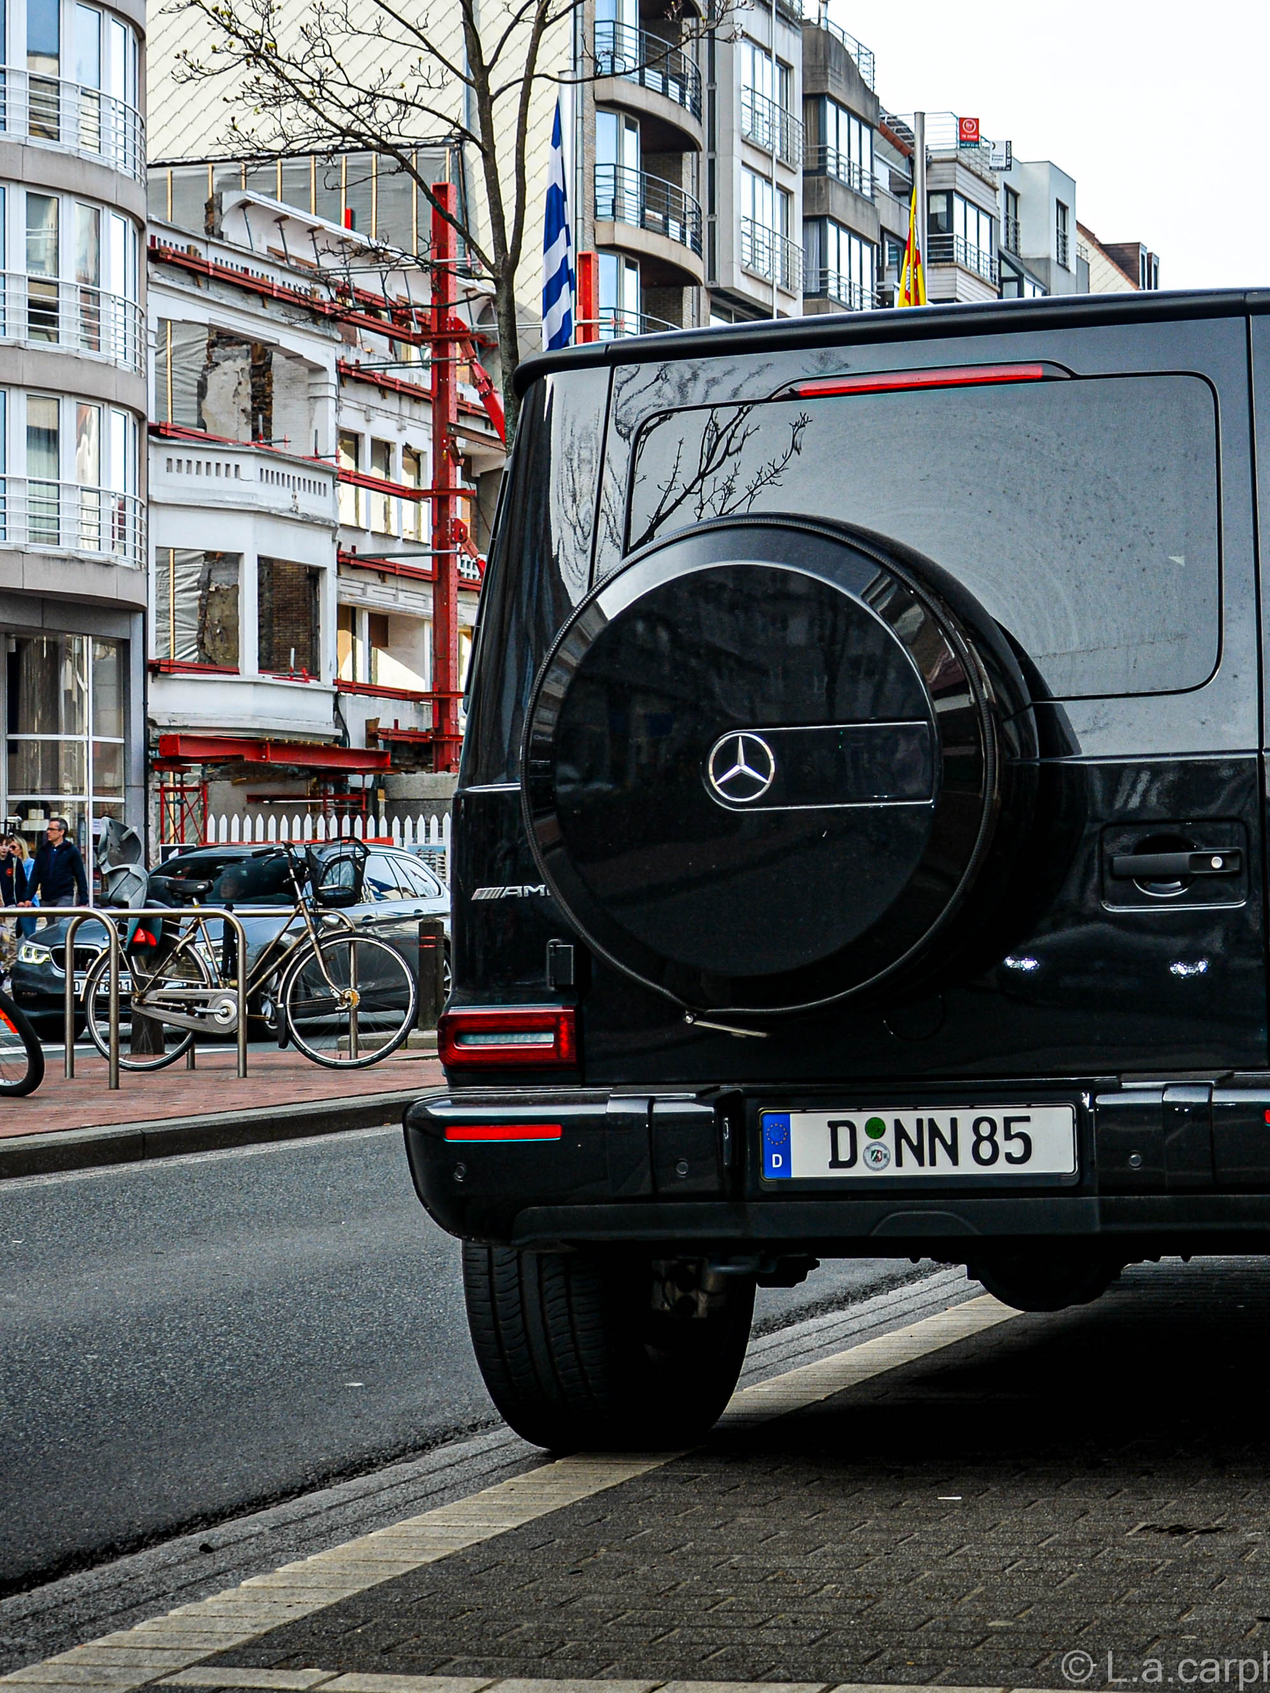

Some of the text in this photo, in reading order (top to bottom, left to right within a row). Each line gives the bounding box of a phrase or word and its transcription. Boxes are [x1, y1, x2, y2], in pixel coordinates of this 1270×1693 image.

[500, 884, 551, 898] AM
[827, 1115, 1033, 1169] D NN 85
[772, 1153, 783, 1168] D
